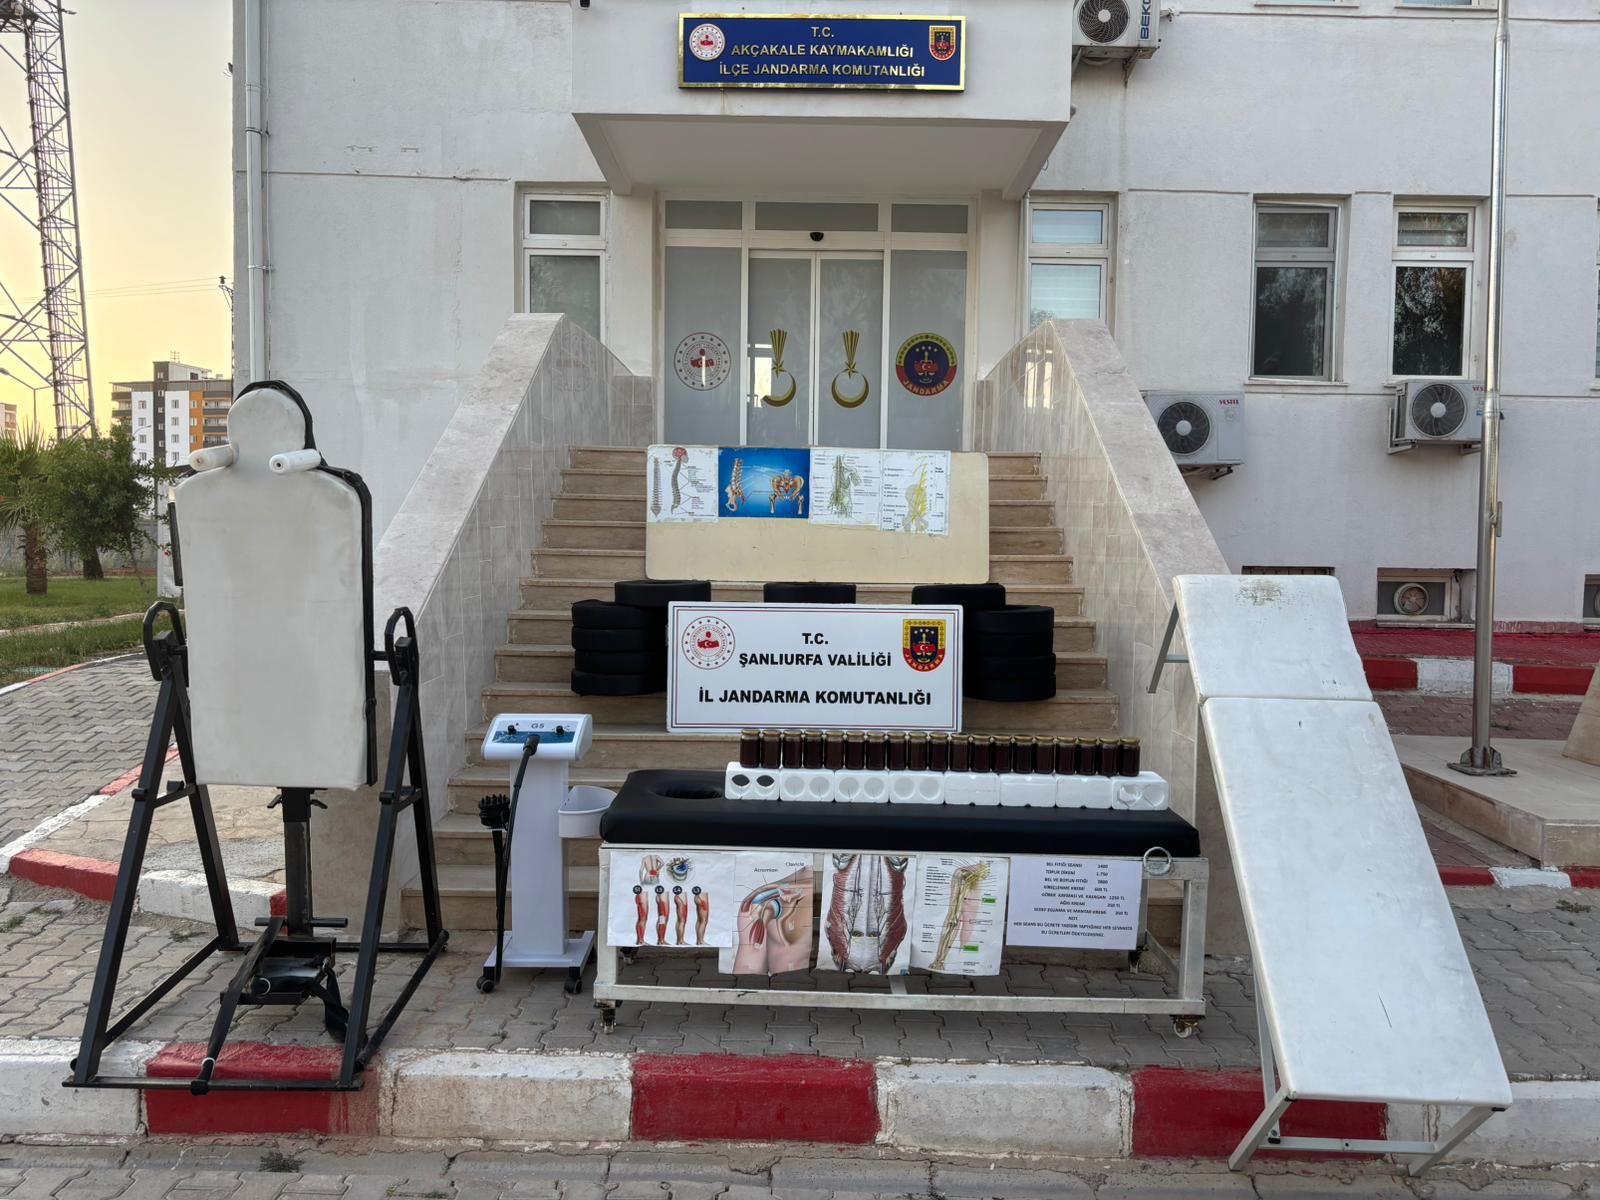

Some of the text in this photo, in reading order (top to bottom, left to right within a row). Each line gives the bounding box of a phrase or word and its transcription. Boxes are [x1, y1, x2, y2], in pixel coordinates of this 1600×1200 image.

[811, 26, 834, 37] T.C.
[731, 44, 806, 58] AKÇAKALE
[810, 43, 914, 58] KAYMAKAMLIĞI
[719, 61, 925, 77] İLÇE JANDARMA KOMUTANLIĞI
[903, 380, 949, 395] JANDARMA
[802, 633, 829, 645] T.C.
[739, 651, 892, 668] ŞANLIURFA VALİLİĞİ
[698, 686, 931, 705] İL JANDARMA KOMUTANLIĞI
